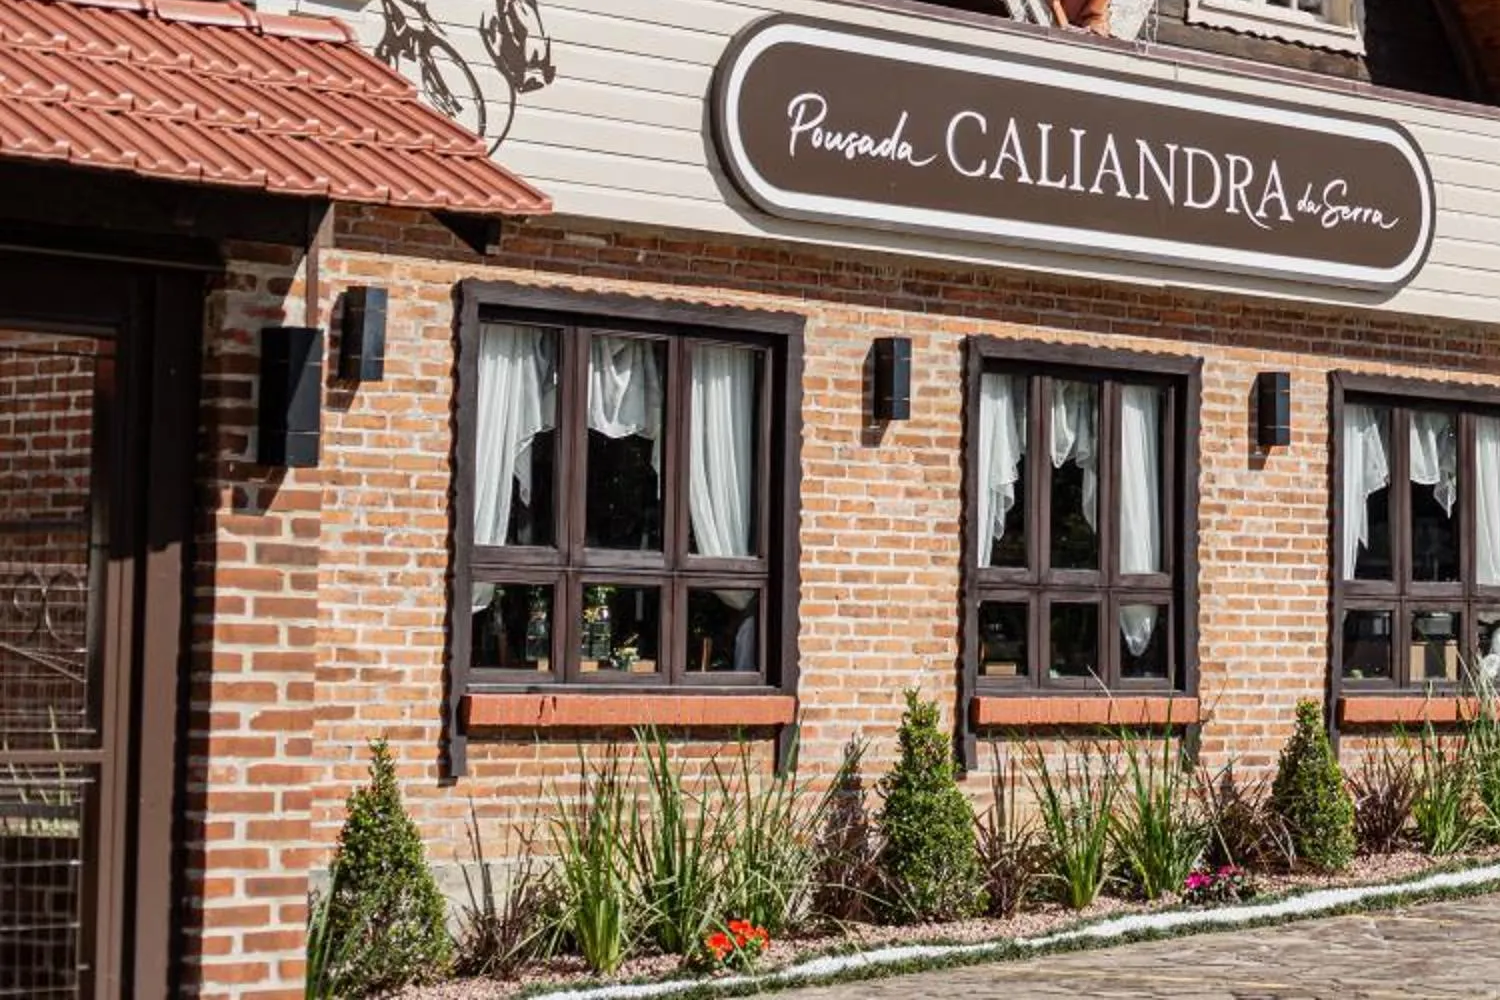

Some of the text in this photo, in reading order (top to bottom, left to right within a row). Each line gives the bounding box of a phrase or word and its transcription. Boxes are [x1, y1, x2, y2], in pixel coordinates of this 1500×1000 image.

[787, 92, 1399, 229] Pousada CALIANDRA da Serra
